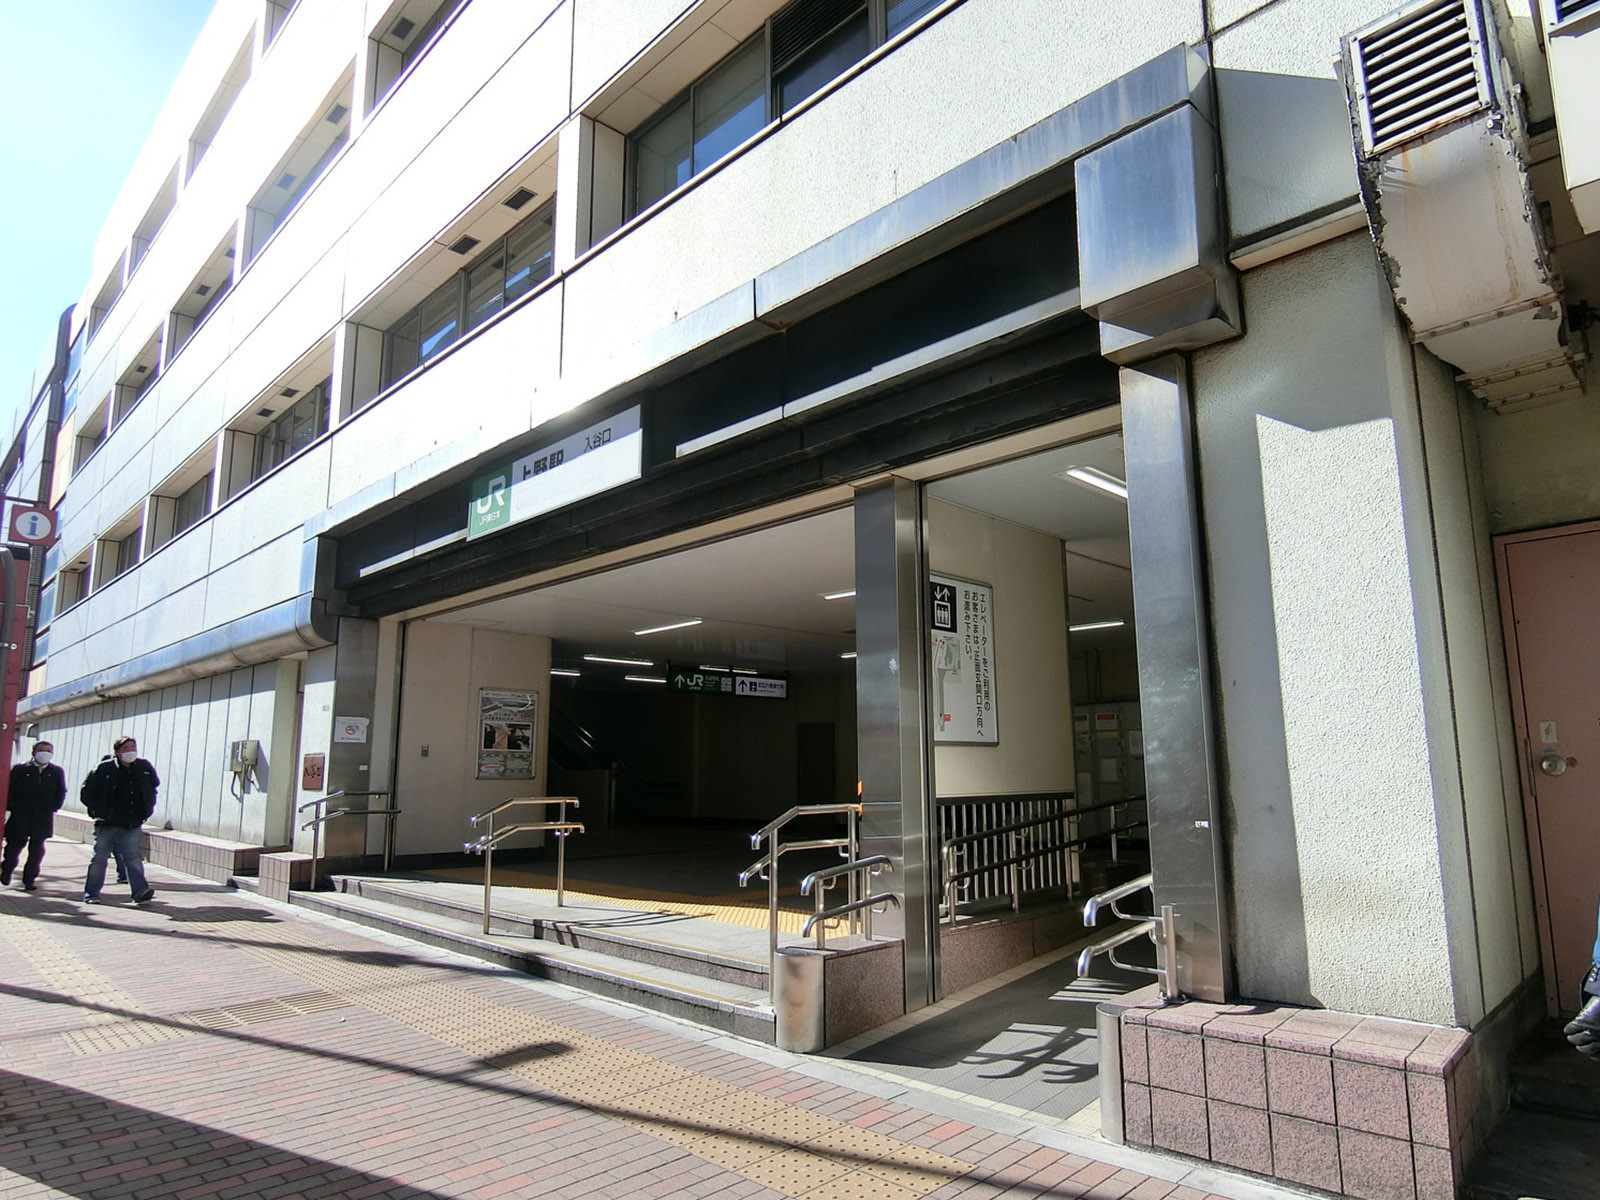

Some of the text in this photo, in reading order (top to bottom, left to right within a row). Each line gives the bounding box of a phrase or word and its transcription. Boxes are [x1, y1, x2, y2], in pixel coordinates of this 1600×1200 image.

[583, 428, 612, 454] 入谷口
[476, 475, 507, 515] JR
[686, 674, 704, 687] JR
